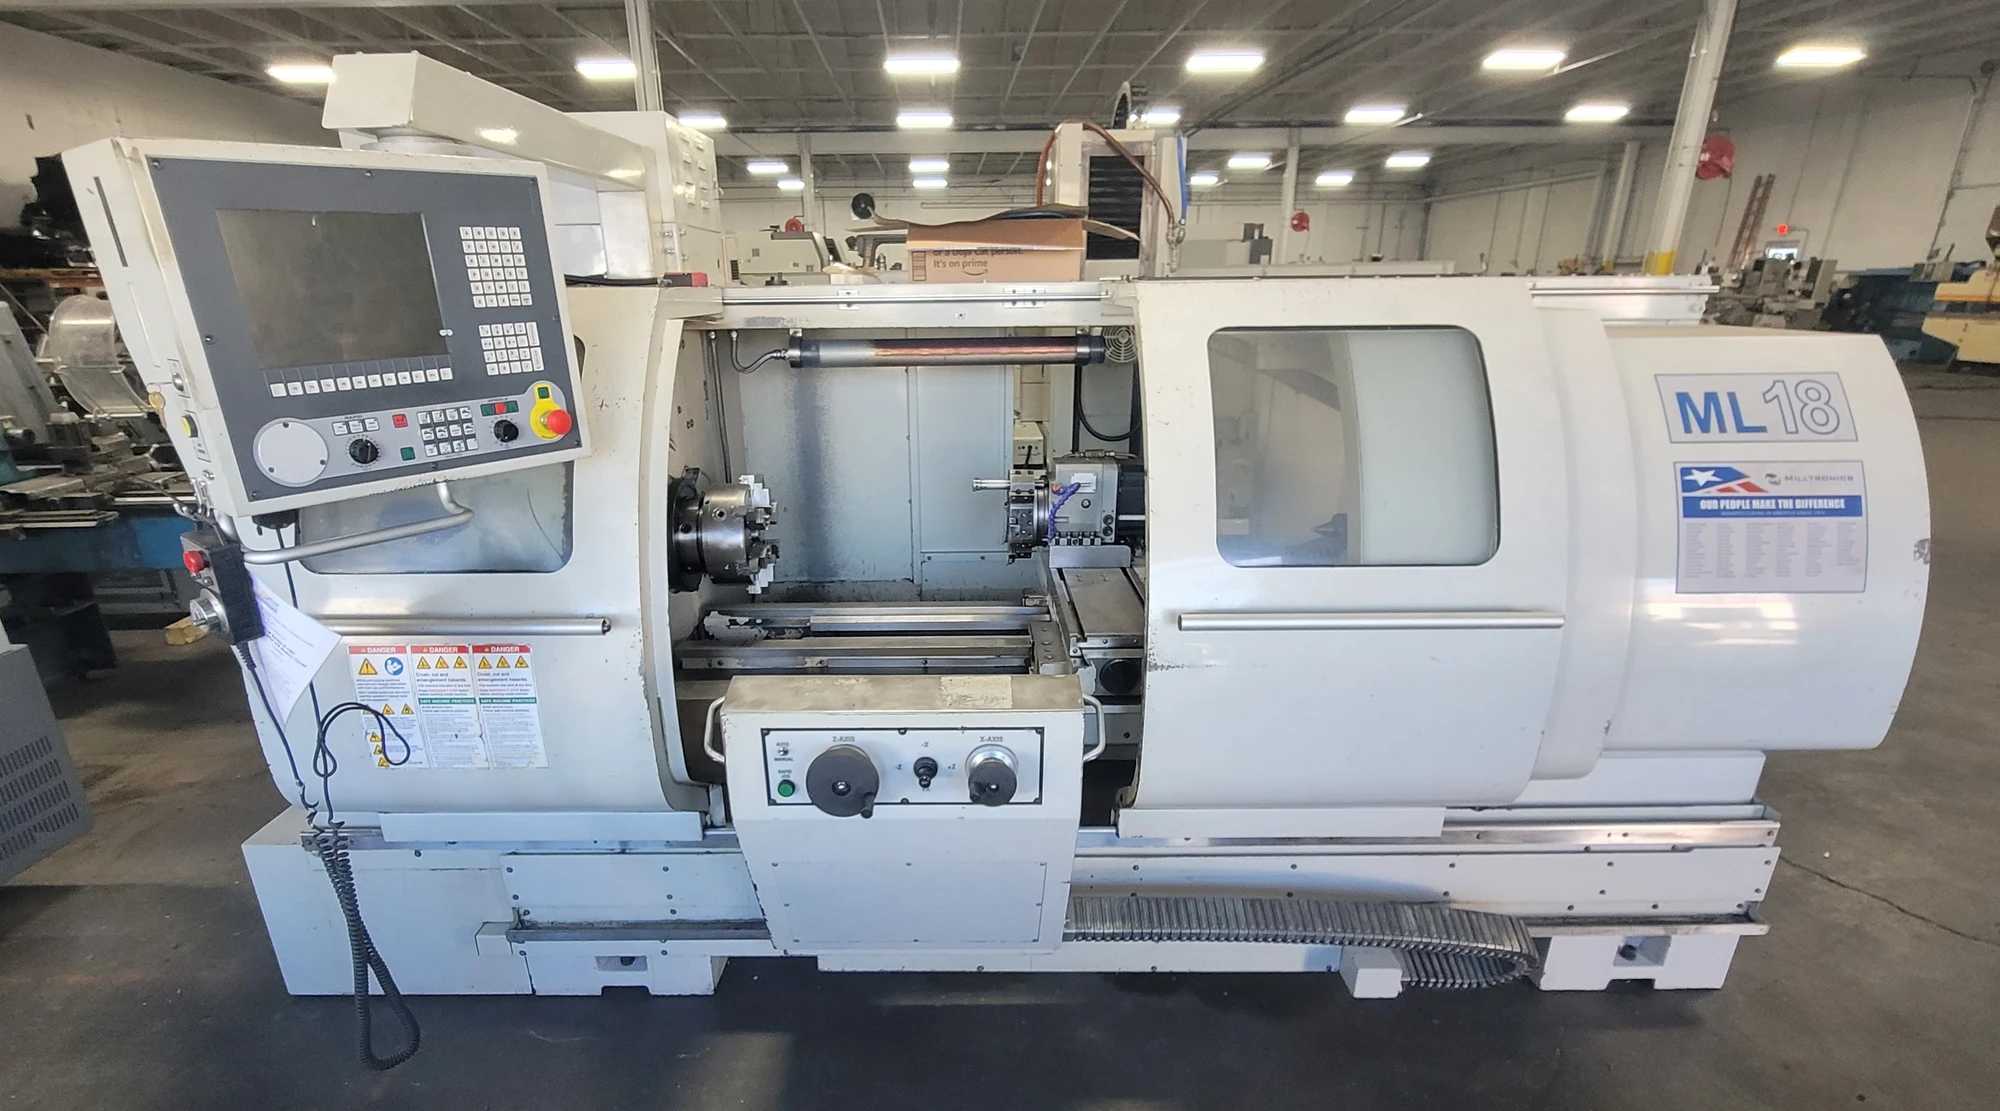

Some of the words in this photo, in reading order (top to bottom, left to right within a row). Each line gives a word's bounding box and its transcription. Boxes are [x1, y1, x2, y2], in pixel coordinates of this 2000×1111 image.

[933, 260, 946, 268] It's
[961, 258, 988, 269] prime
[1700, 499, 1719, 510] OUR
[1720, 499, 1751, 510] PEOPLE
[1752, 499, 1777, 510] MAKE
[1778, 498, 1794, 510] THE
[1795, 498, 1846, 510] DIFFERENCE
